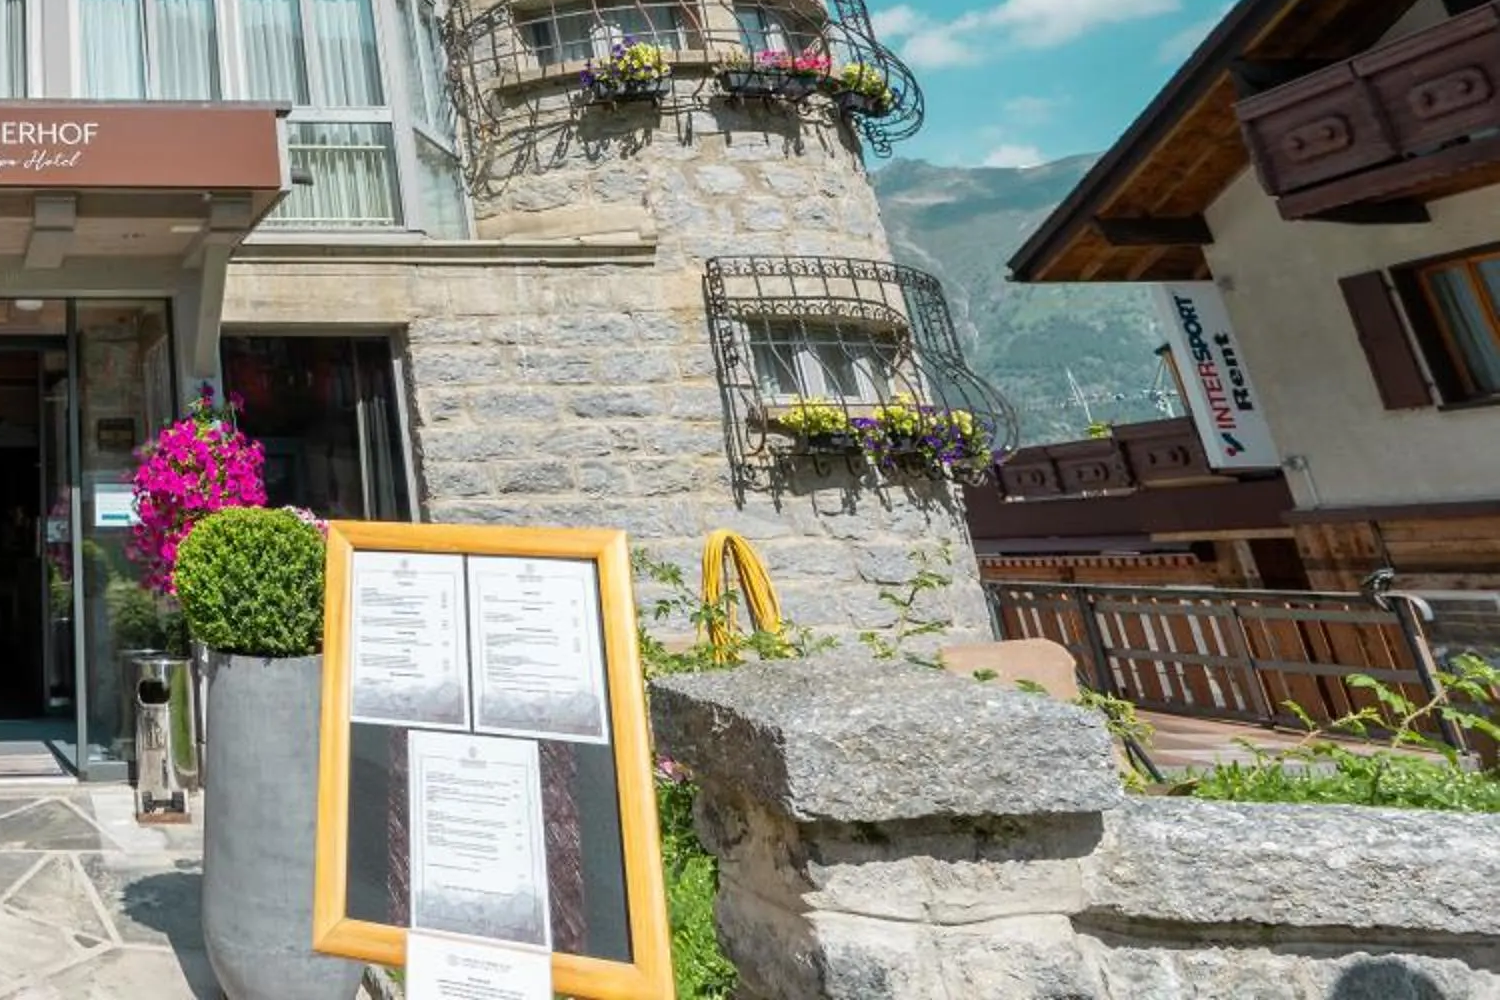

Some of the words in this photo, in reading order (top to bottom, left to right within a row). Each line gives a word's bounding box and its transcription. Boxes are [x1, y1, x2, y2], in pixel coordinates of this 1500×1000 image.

[23, 149, 82, 171] Hotel
[1173, 294, 1237, 429] INTERSPORT
[1214, 332, 1254, 411] Rent
